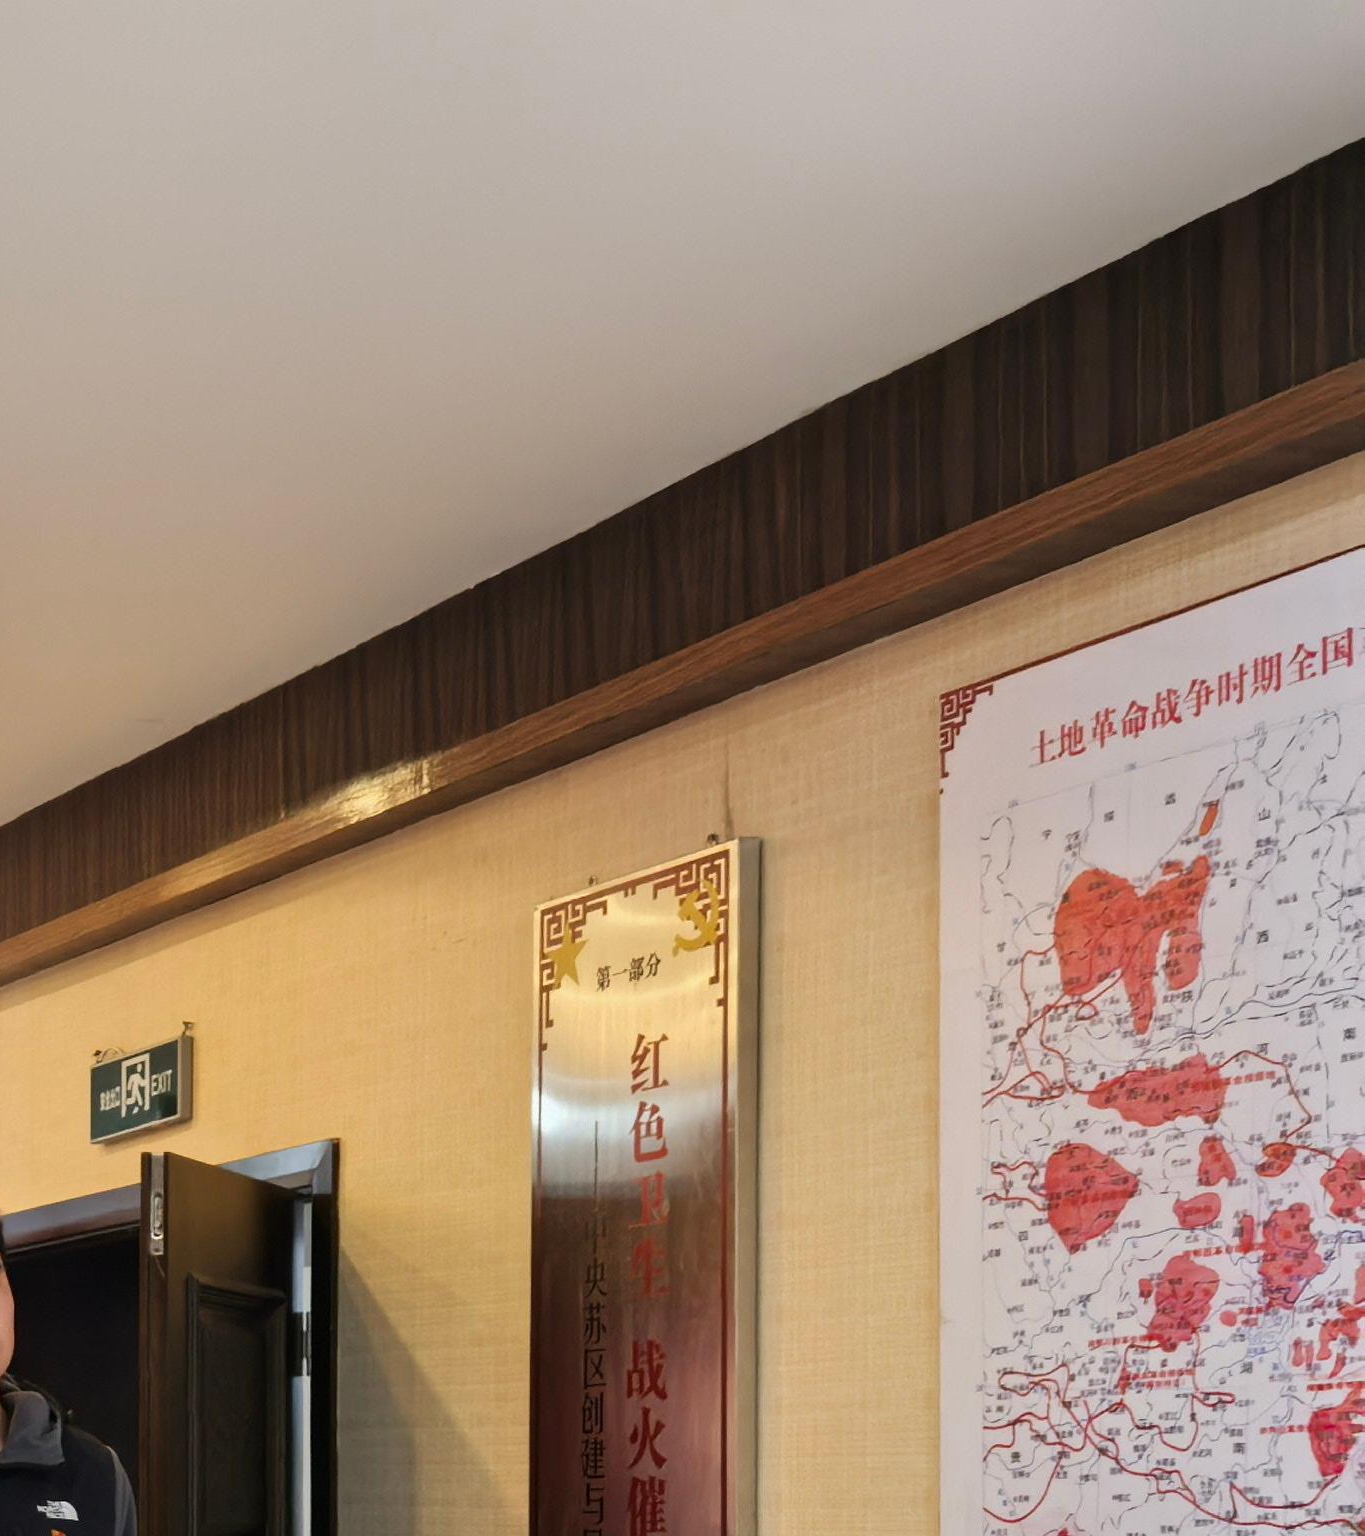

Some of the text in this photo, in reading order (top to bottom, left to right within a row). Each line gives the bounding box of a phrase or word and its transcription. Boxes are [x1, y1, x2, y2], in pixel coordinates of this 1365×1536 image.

[1028, 626, 1365, 769] 土地革命战争时期全国
[595, 951, 662, 993] 第一部分
[150, 1069, 173, 1097] EXIT
